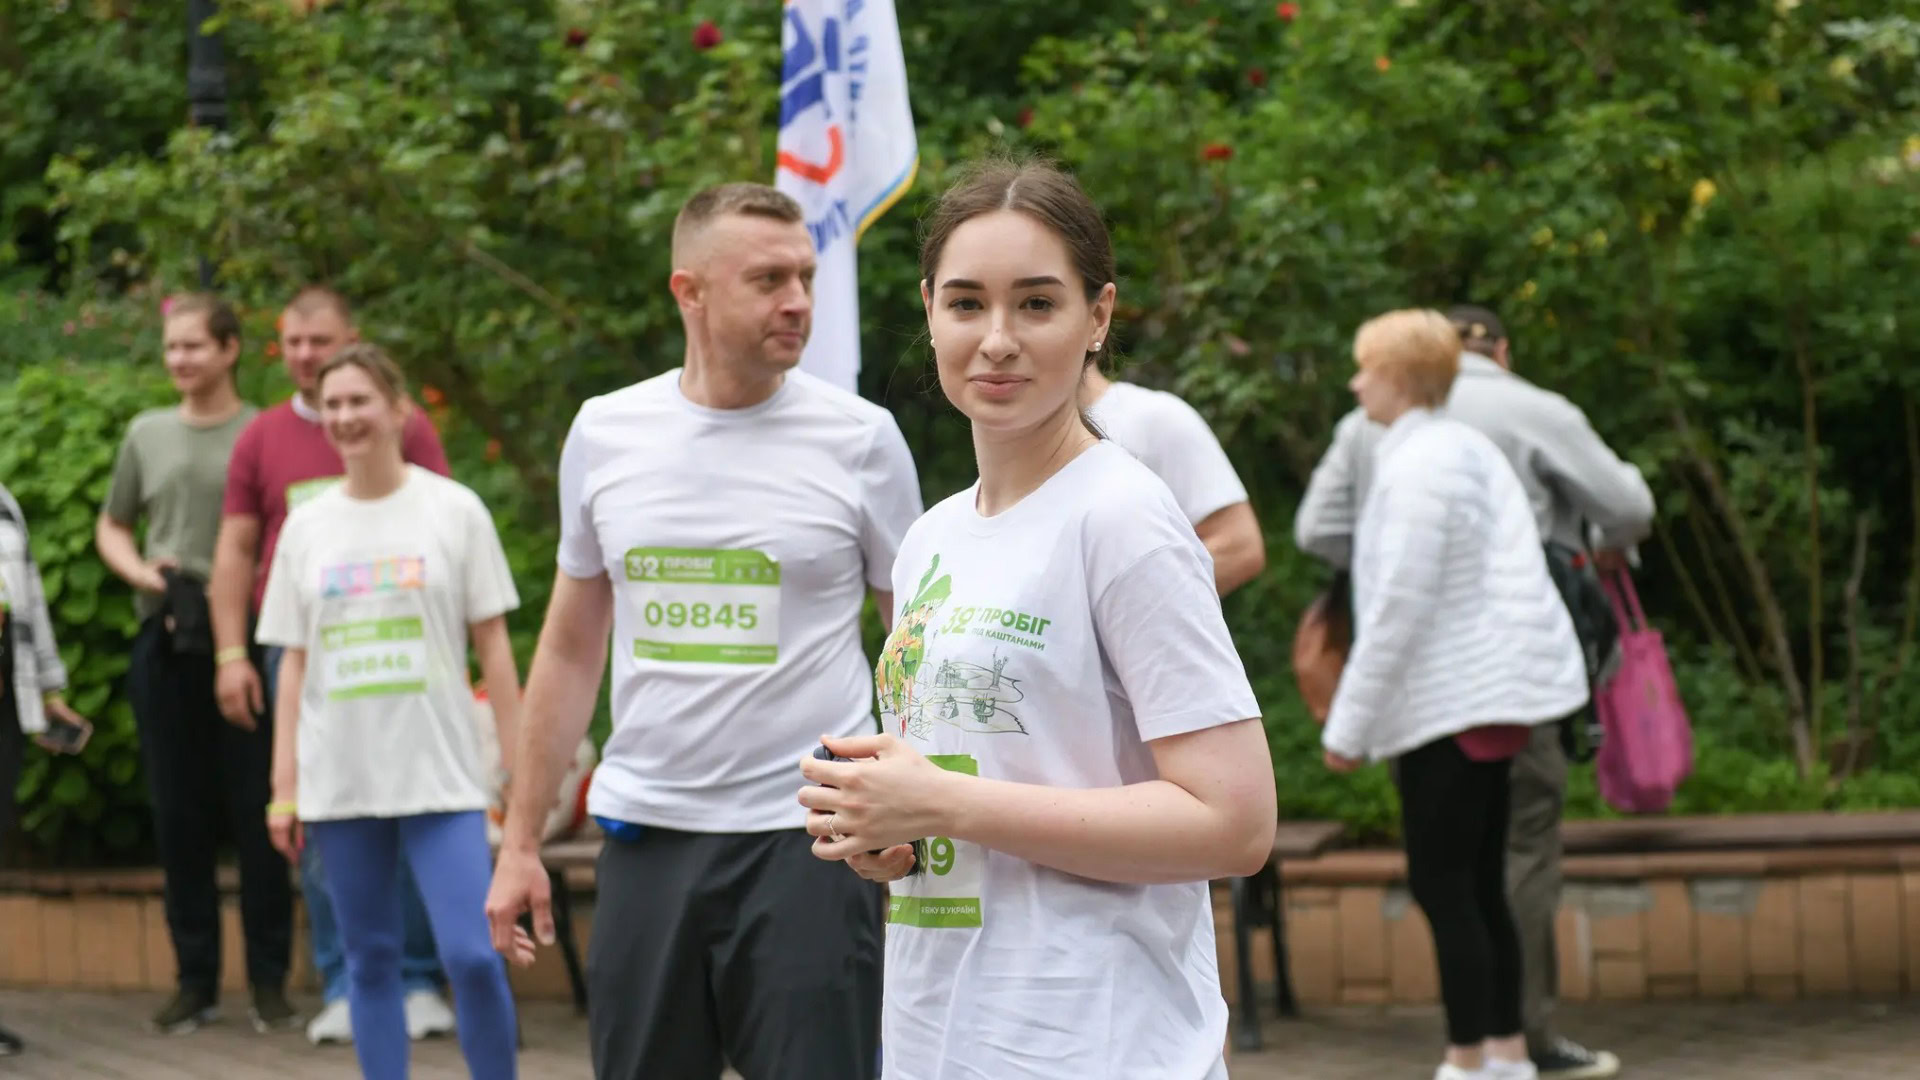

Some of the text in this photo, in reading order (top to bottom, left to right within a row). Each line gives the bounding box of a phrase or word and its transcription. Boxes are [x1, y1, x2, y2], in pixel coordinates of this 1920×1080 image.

[645, 602, 757, 630] 09845
[979, 607, 1052, 636] ПРОБІГ
[985, 629, 1045, 651] КАШТАНАМИ
